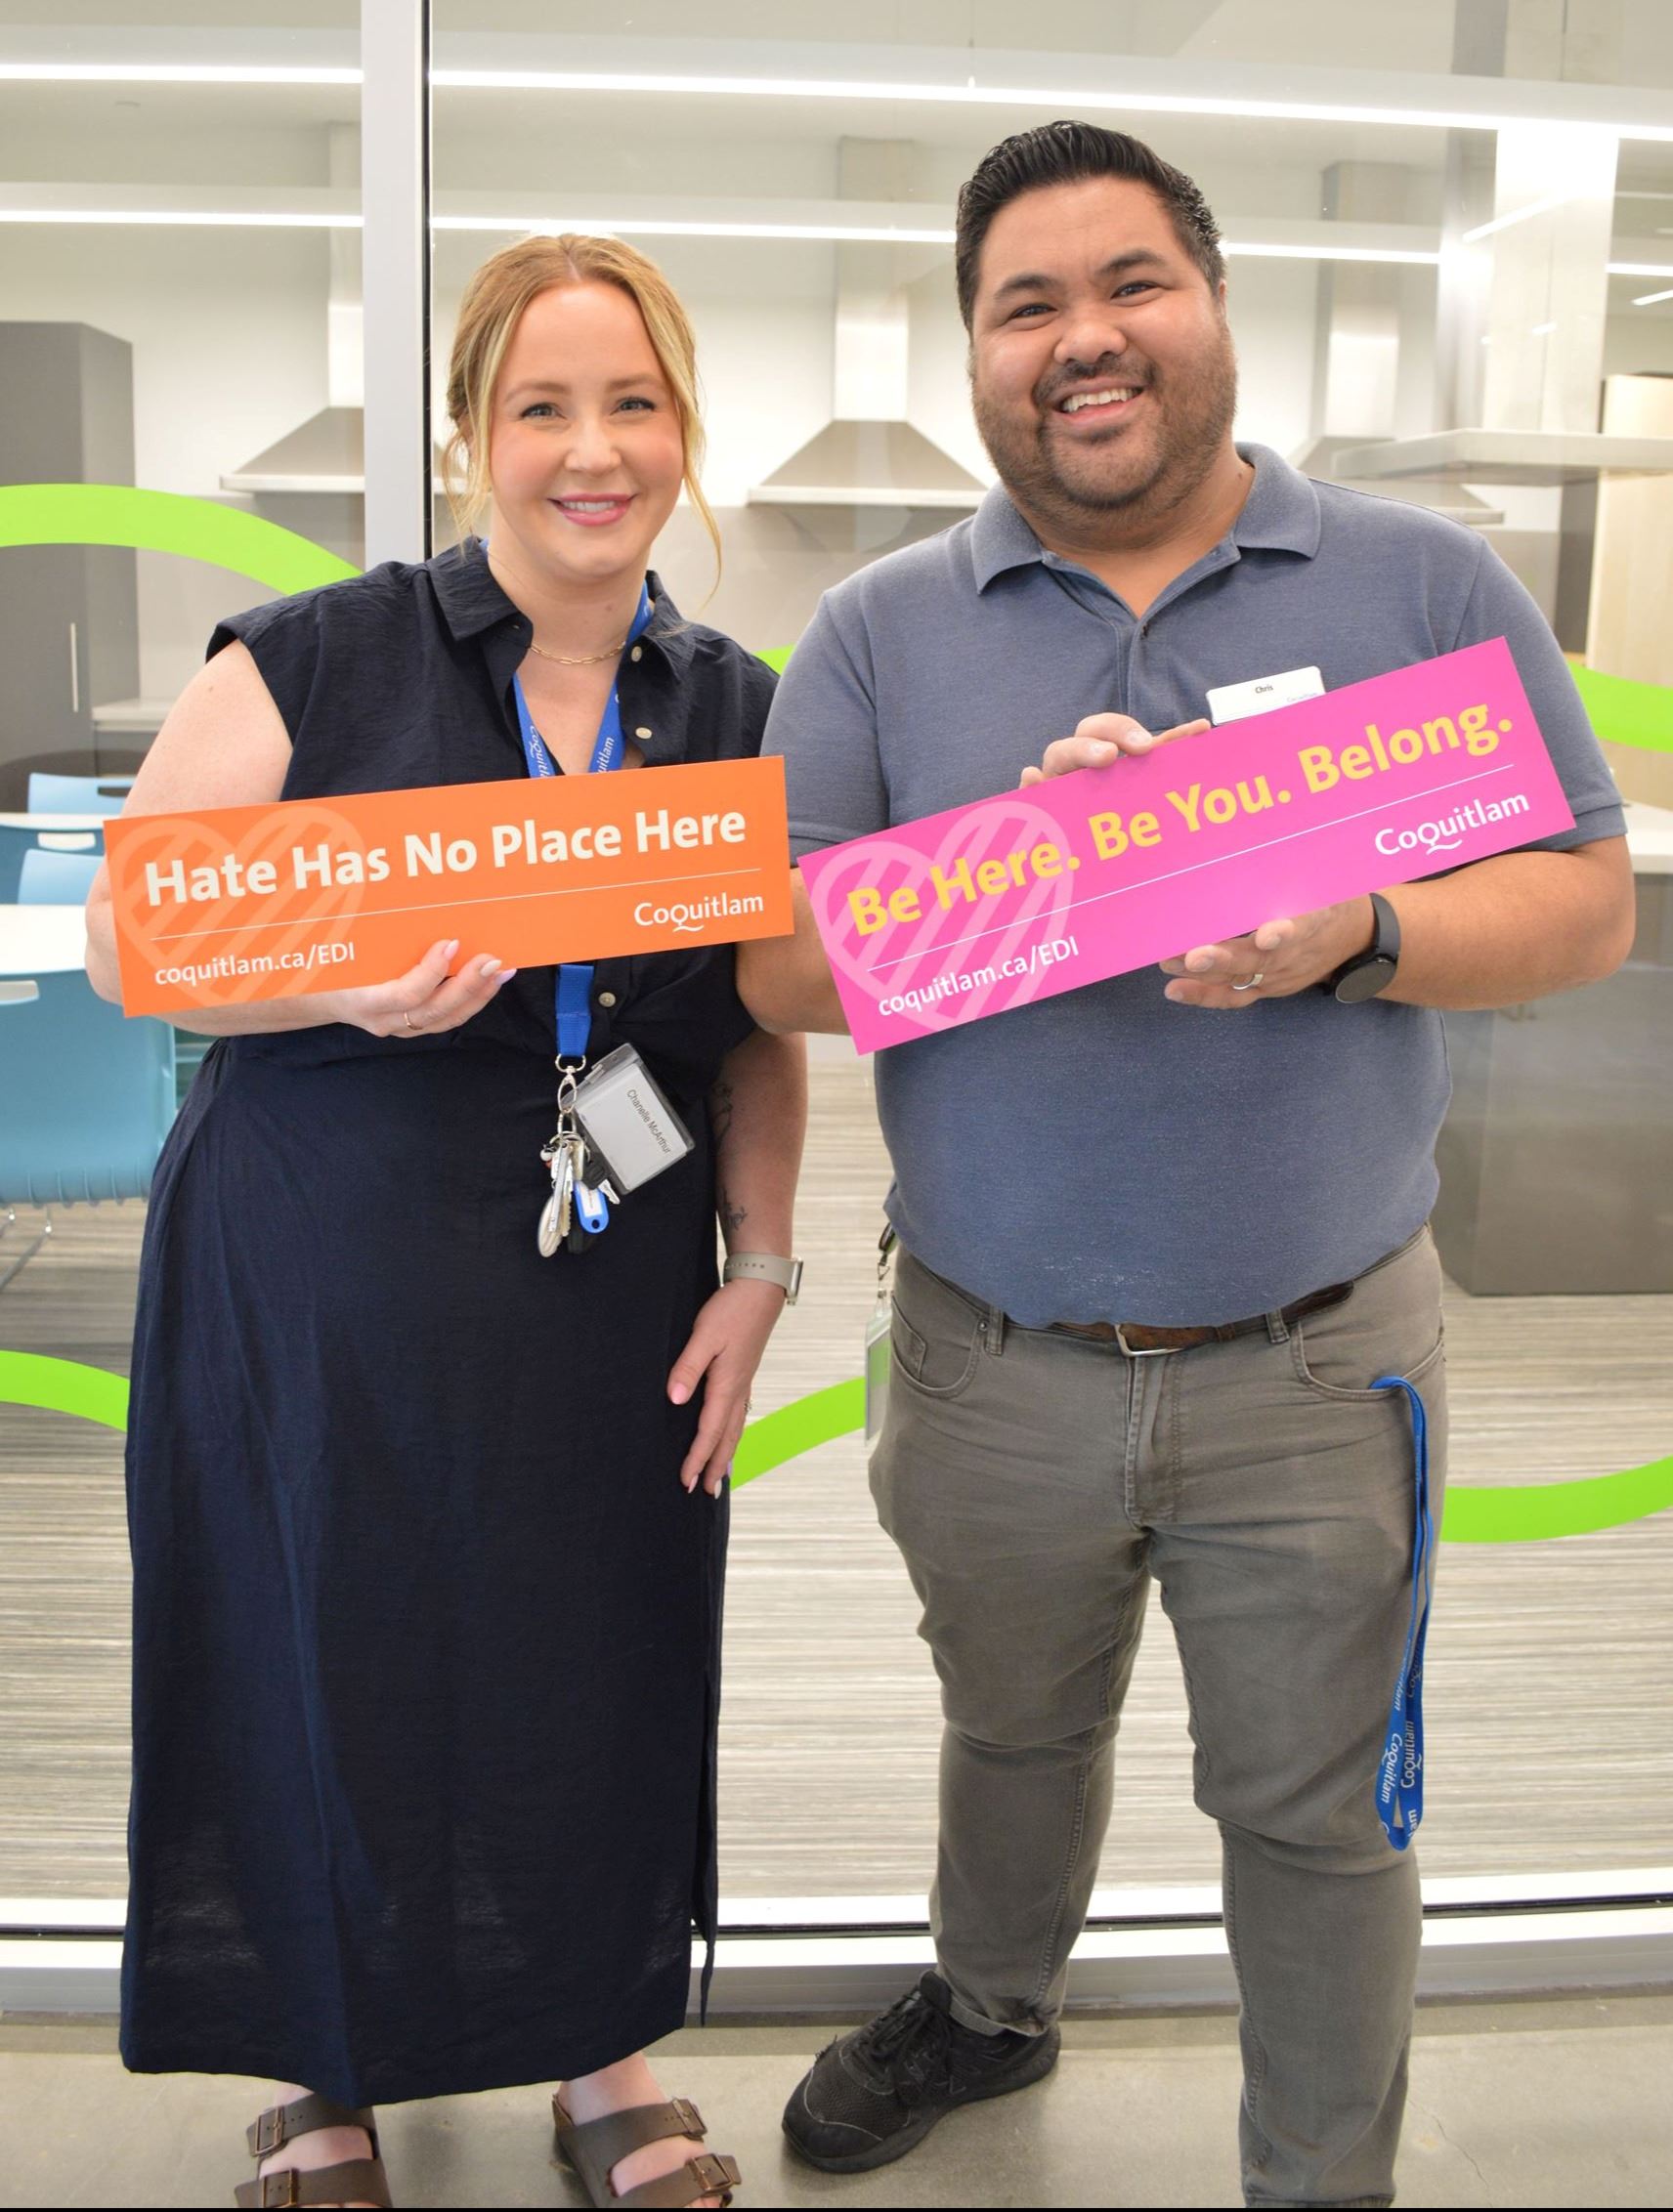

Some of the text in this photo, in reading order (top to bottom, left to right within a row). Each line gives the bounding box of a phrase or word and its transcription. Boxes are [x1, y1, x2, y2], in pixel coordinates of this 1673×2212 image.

[1255, 685, 1274, 695] Chris
[846, 702, 1513, 937] Be Here. Be You. Belong.
[146, 809, 746, 906] Hate Has No Place Here
[155, 939, 356, 987] coquitlam.ca/EDI
[879, 934, 1079, 1016] coquitlam.ca/EDI
[626, 1088, 671, 1154] Chanelle McArthur
